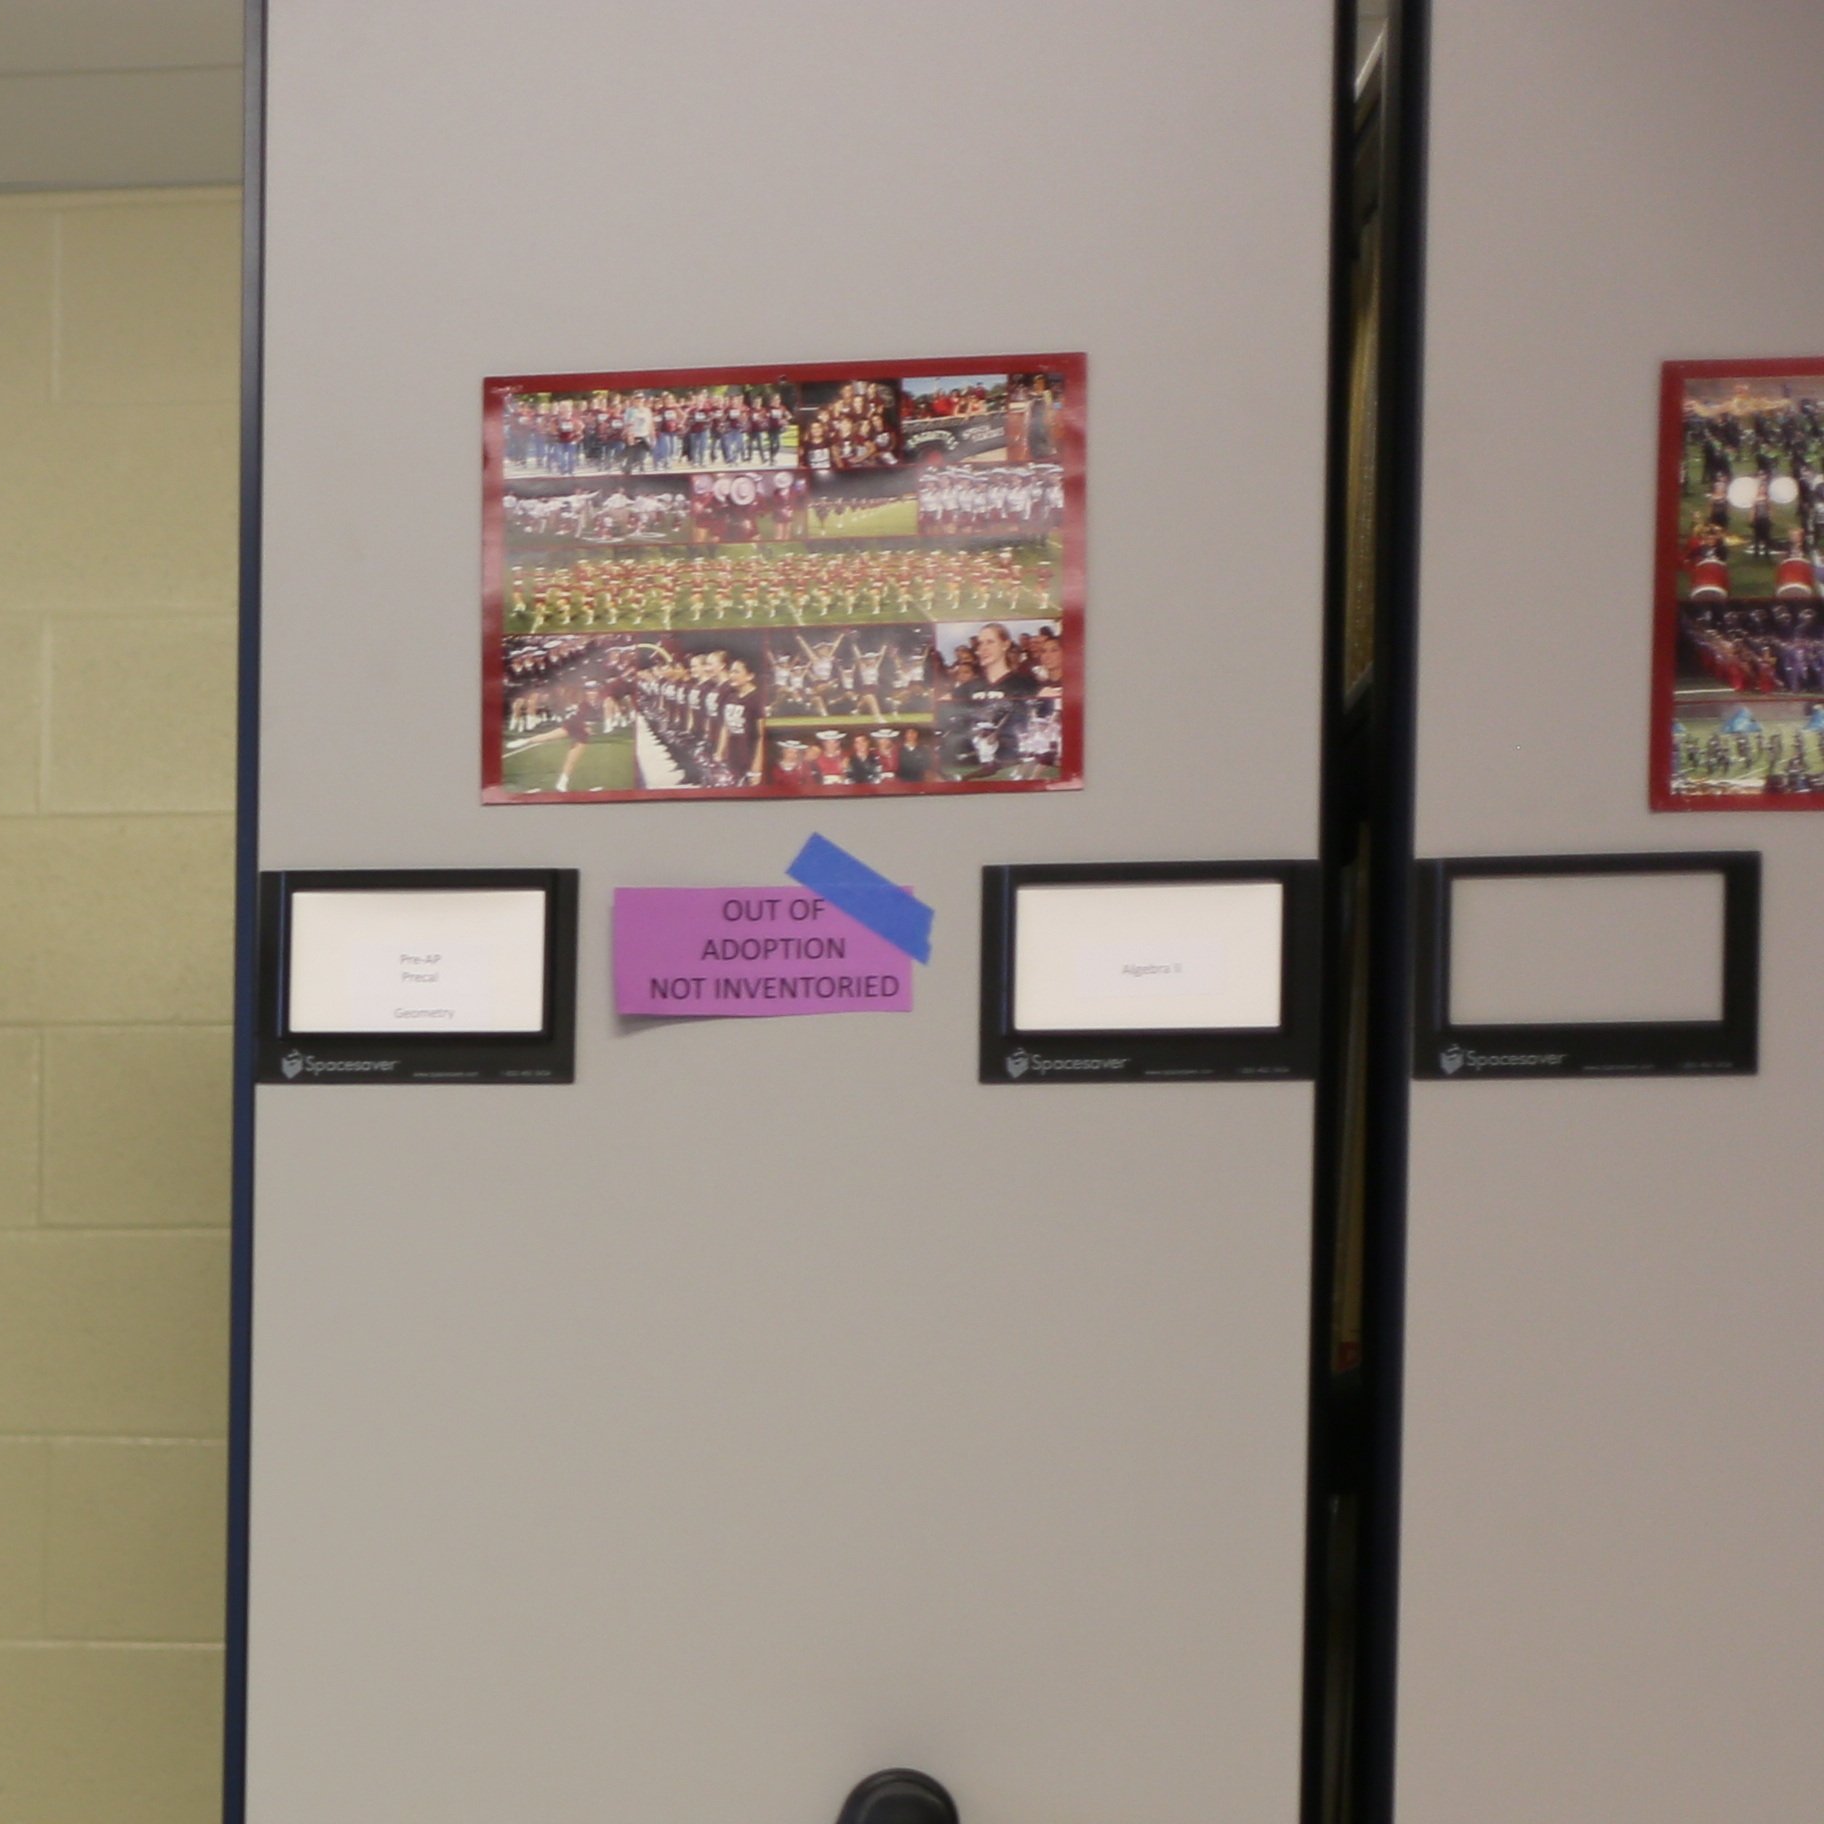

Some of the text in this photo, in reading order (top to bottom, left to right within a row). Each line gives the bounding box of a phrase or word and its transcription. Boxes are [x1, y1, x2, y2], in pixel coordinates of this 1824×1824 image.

[722, 898, 826, 922] OUT OF
[700, 937, 847, 961] ADOPTION
[650, 974, 900, 1000] NOT INVENTORIED
[394, 1007, 456, 1020] Geometry
[304, 1055, 398, 1076] Spacesaver
[1031, 1053, 1128, 1076] Spacesaver
[1465, 1049, 1566, 1072] Spacesaver
